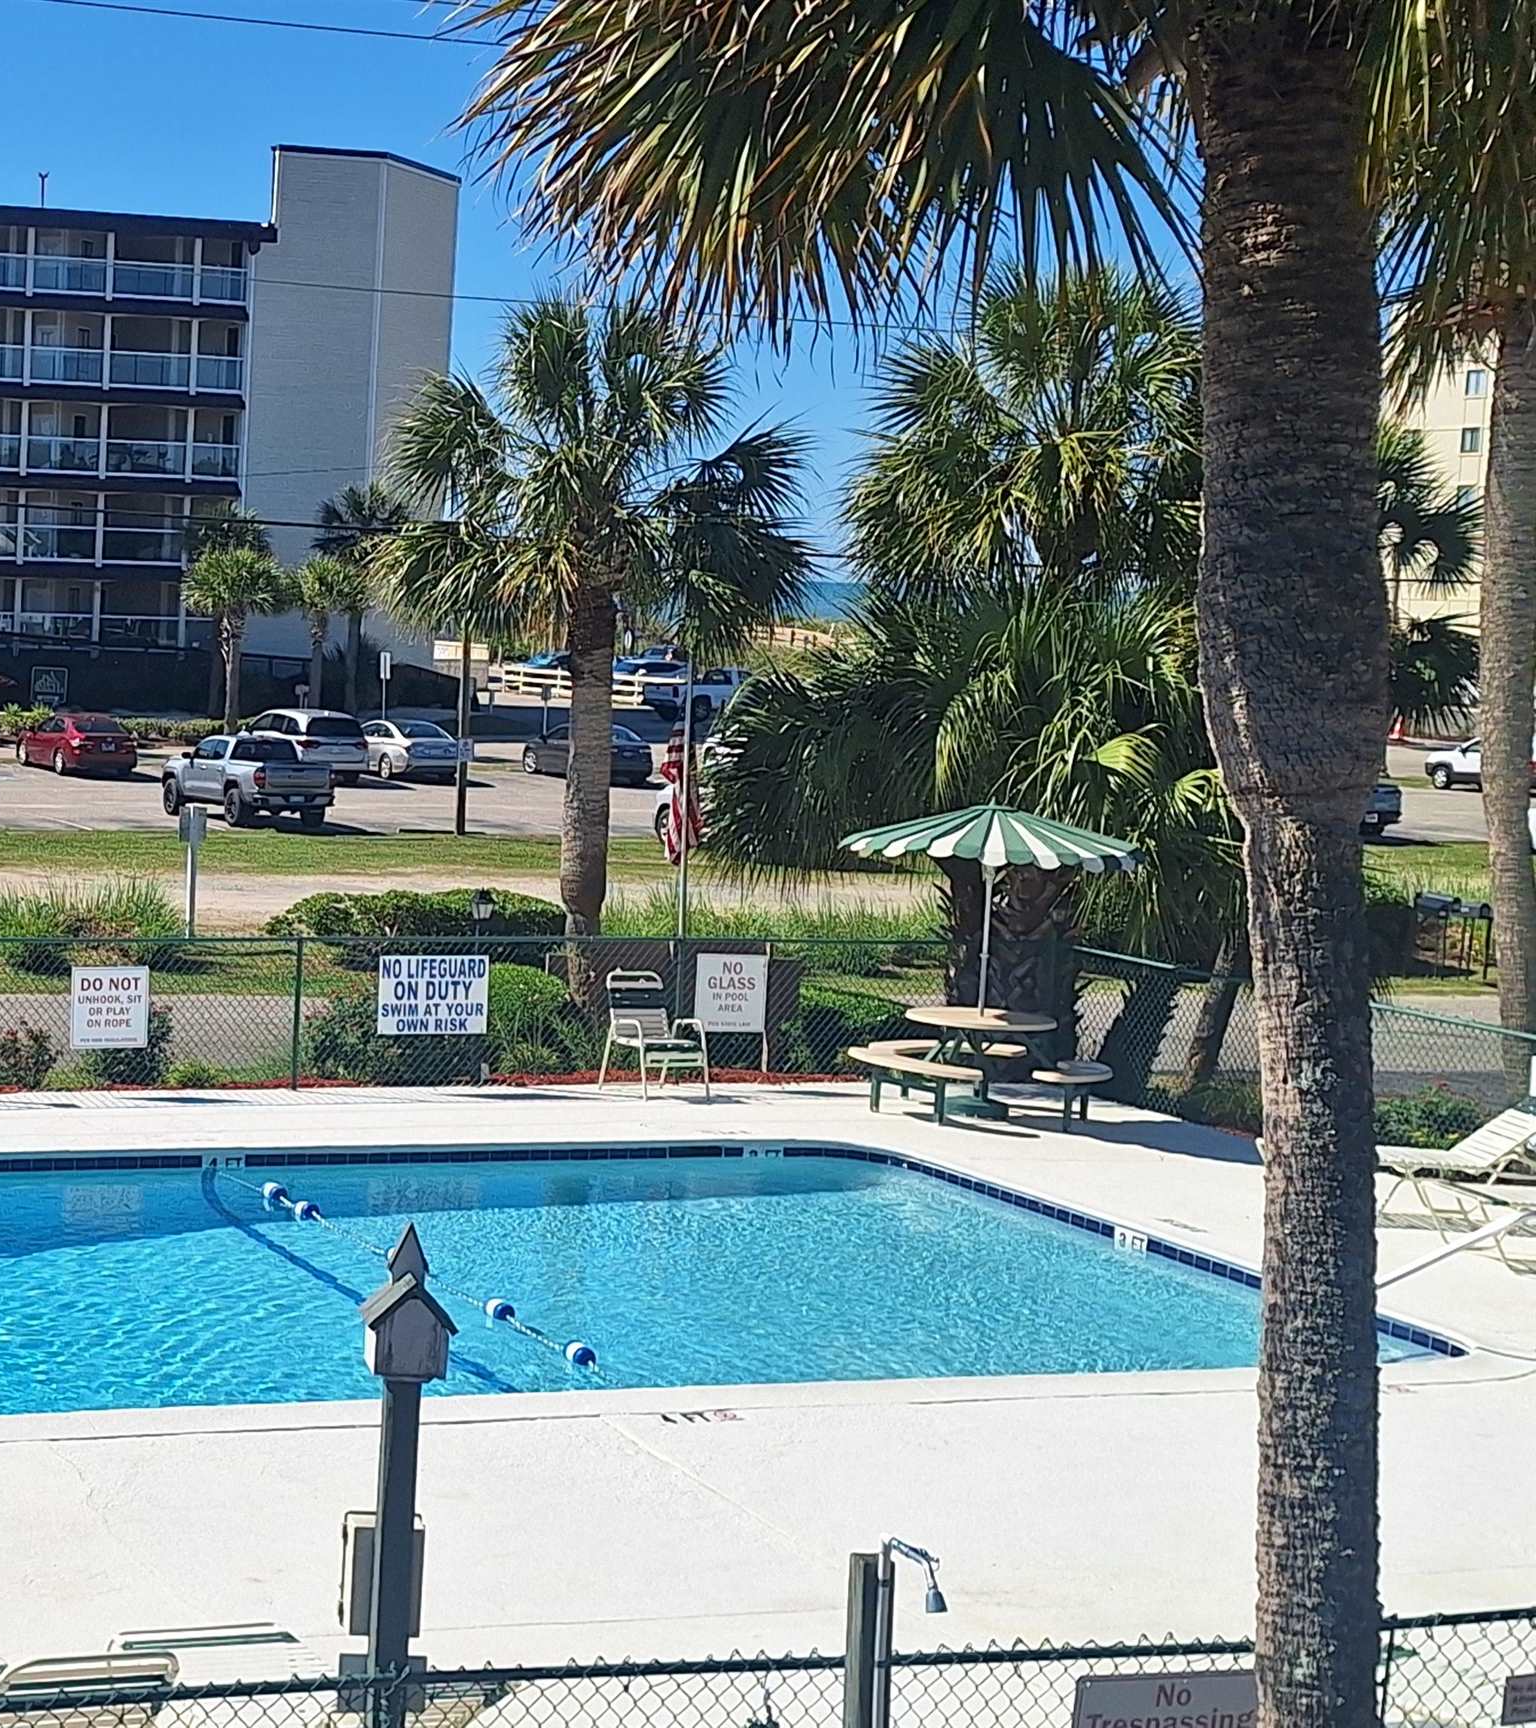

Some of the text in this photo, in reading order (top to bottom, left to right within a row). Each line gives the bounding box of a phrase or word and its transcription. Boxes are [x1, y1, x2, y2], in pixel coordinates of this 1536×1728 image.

[382, 958, 486, 979] NO LIFEGUARD
[723, 961, 743, 975] NO
[80, 977, 141, 992] DO NOT
[708, 976, 756, 990] GLASS
[394, 980, 473, 1001] ON DUTY
[712, 992, 749, 1002] IN POOL
[78, 995, 143, 1005] UNHOOK, SIT
[88, 1007, 132, 1017] OR PLAY
[381, 1003, 484, 1017] SWIM AT YOUR
[717, 1004, 743, 1013] AREA
[87, 1018, 133, 1029] ON ROPE
[396, 1018, 468, 1032] OWN RISK
[225, 1157, 243, 1168] FT
[679, 1411, 711, 1423] FT
[1155, 1684, 1192, 1707] No
